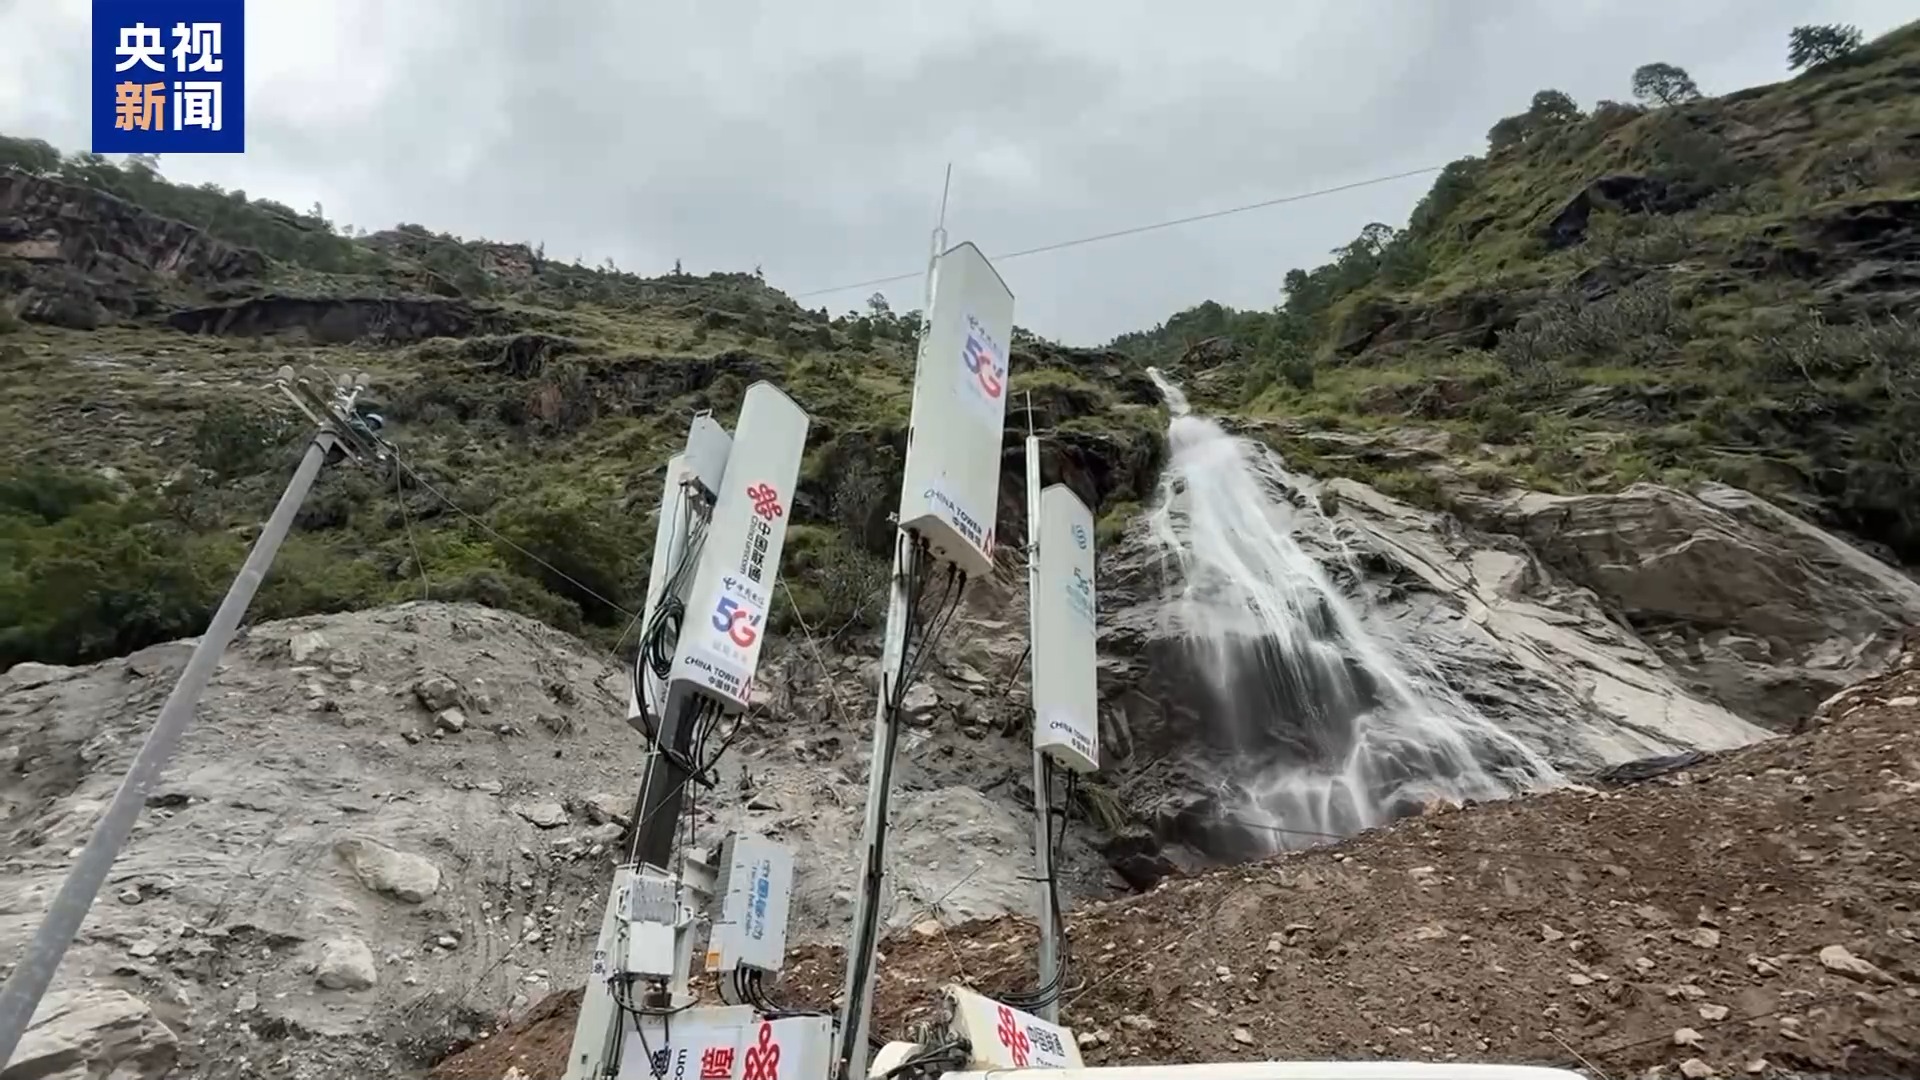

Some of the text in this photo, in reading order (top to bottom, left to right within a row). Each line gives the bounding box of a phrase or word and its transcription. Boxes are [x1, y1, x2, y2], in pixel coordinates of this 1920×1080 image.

[963, 335, 1002, 398] 5G
[923, 488, 955, 512] CHINA
[747, 521, 771, 584] 中国联通
[712, 596, 757, 648] 5G
[684, 656, 740, 685] CHINA TOWER
[701, 1047, 735, 1079] 障
